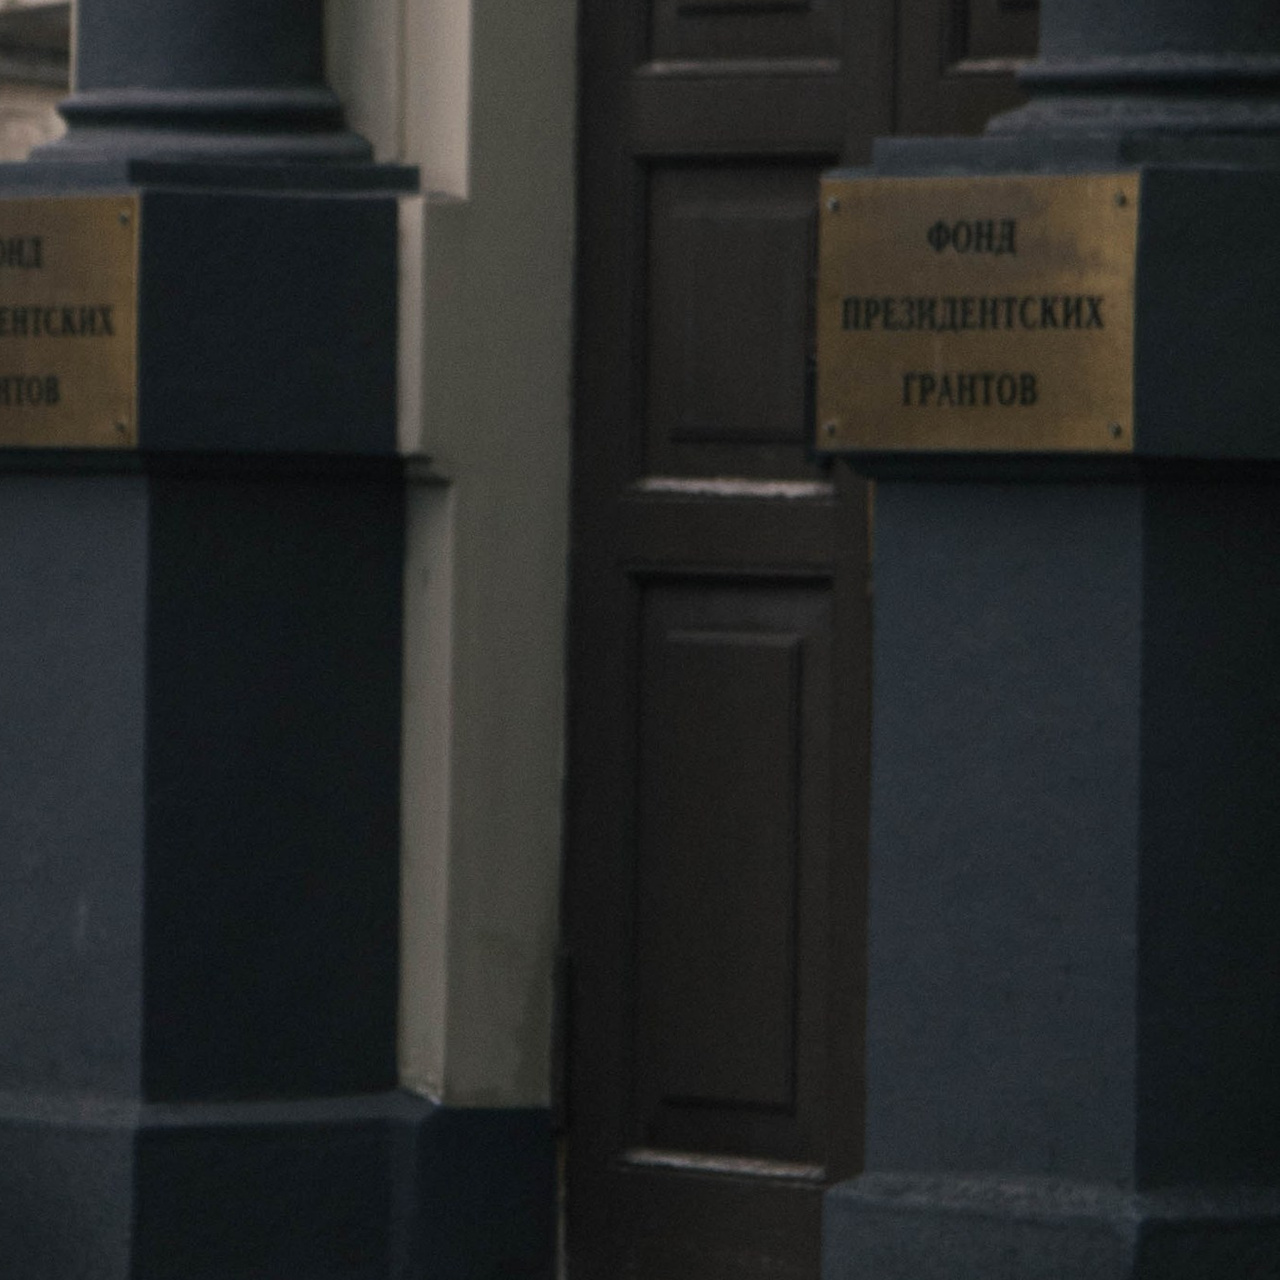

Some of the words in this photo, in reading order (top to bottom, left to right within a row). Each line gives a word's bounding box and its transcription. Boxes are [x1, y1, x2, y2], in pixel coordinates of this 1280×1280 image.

[927, 220, 1017, 254] ФОНД
[842, 295, 1104, 331] ПРЕЗИДЕНТСКИХ
[902, 373, 1038, 407] ГРАНТОВ
